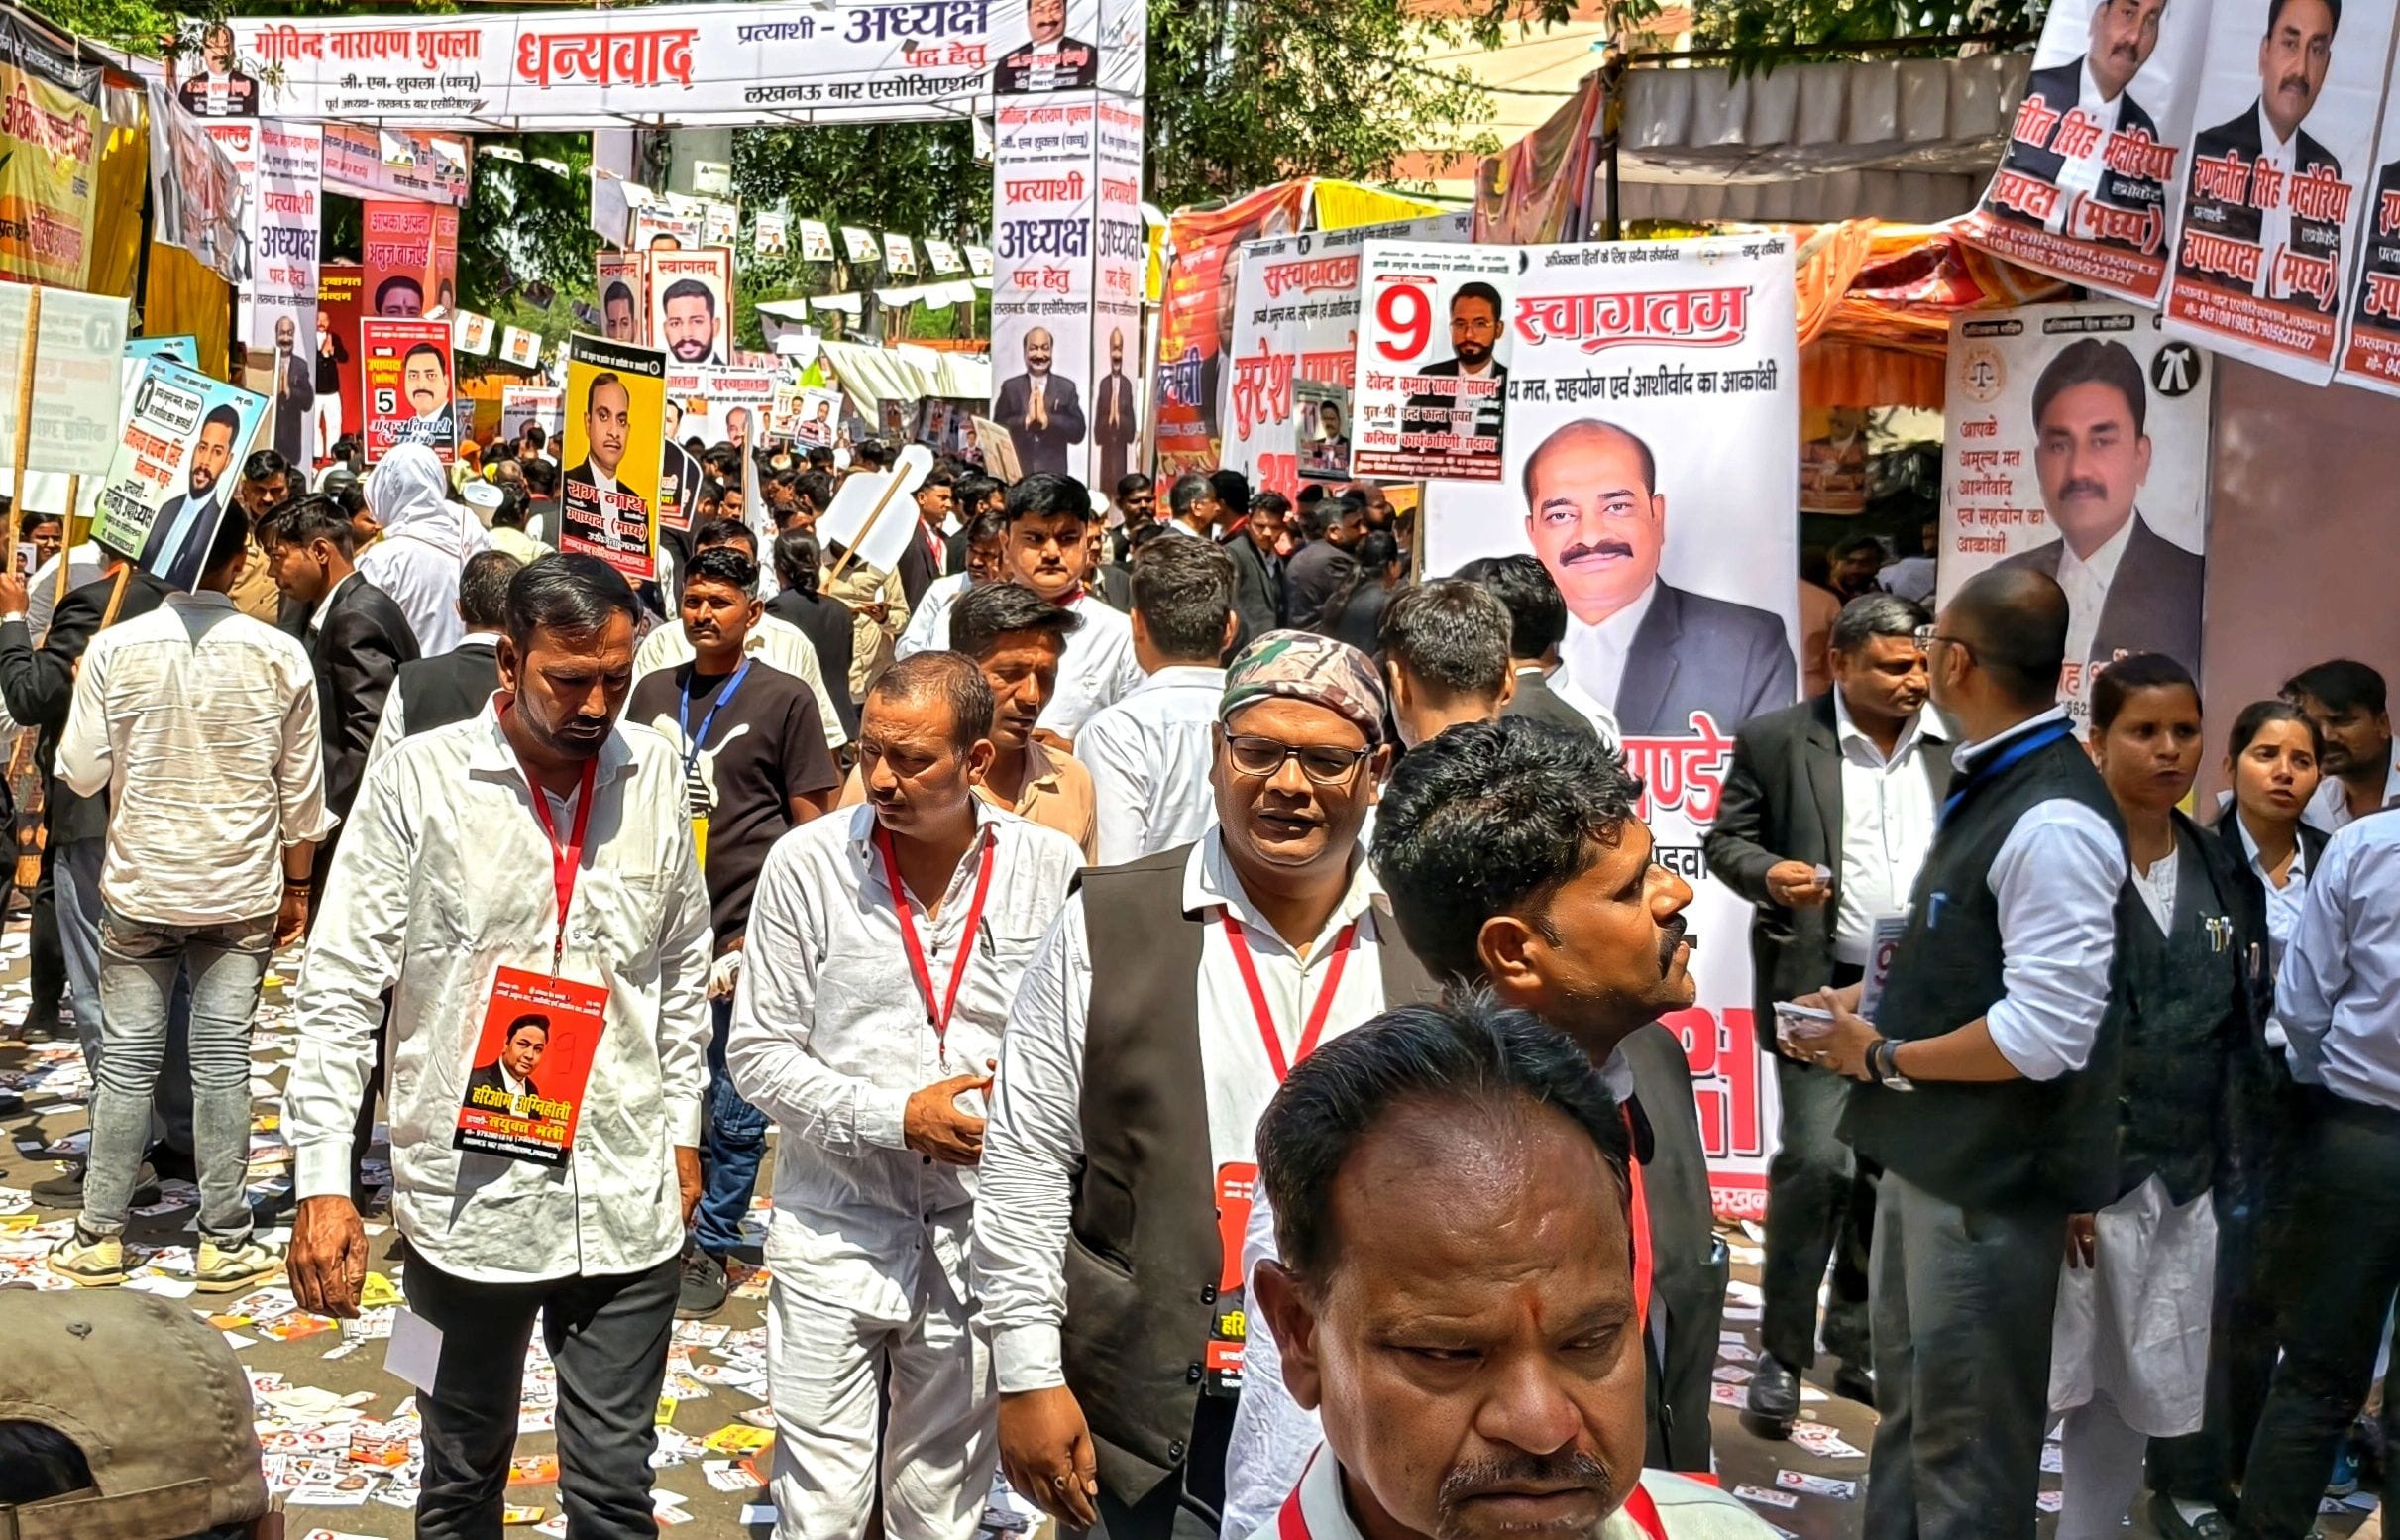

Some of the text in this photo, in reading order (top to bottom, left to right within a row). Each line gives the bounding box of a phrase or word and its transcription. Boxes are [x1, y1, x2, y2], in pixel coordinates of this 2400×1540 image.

[737, 16, 815, 45] प्रत्याशी
[844, 1, 989, 44] अध्यक्ष
[255, 24, 482, 70] गोविन्द नारायण शुक्ला
[516, 29, 700, 89] धन्यवाद
[905, 48, 941, 68] पद
[947, 41, 988, 69] हेतु
[396, 76, 436, 94] शुक्ला
[744, 73, 986, 103] लखनऊ बार एसोसिएशन
[413, 98, 429, 110] बार
[2049, 107, 2102, 159] सिंह
[1005, 170, 1085, 206] प्रत्याशी
[1102, 176, 1138, 206] प्रत्याशी
[2194, 149, 2252, 205] रणजीत
[2249, 155, 2284, 210] सिंह
[264, 189, 314, 215] प्रत्याशी
[2067, 189, 2164, 256] (मध्य)
[259, 225, 318, 262] अध्यक्ष
[998, 217, 1091, 259] अध्यक्ष
[1099, 218, 1140, 262] अध्यक्ष
[2182, 229, 2264, 282] उपाध्यक्ष
[269, 267, 306, 291] पद हेतु
[1013, 265, 1071, 294] पद हेतु
[1105, 266, 1132, 296] पद हेतु
[2270, 242, 2339, 311] (मध्य)
[1375, 284, 1432, 361] 9
[1232, 337, 1296, 442] सुरेश
[1399, 374, 1430, 396] कुमार
[1555, 369, 1606, 403] सहयोग
[1610, 367, 1633, 399] एवं
[1635, 364, 1693, 397] आशीर्वाद
[1697, 371, 1718, 394] का
[1721, 359, 1777, 393] आकांक्षी
[378, 391, 394, 413] 5
[1960, 414, 1998, 438] आपके
[1960, 450, 2021, 473] अमूल्य मत
[1958, 472, 2014, 495] आशीर्वाद
[1957, 501, 2045, 528] एवं सहयोग का
[1957, 528, 2007, 555] आकांक्षी
[472, 1084, 514, 1110] हरिओम
